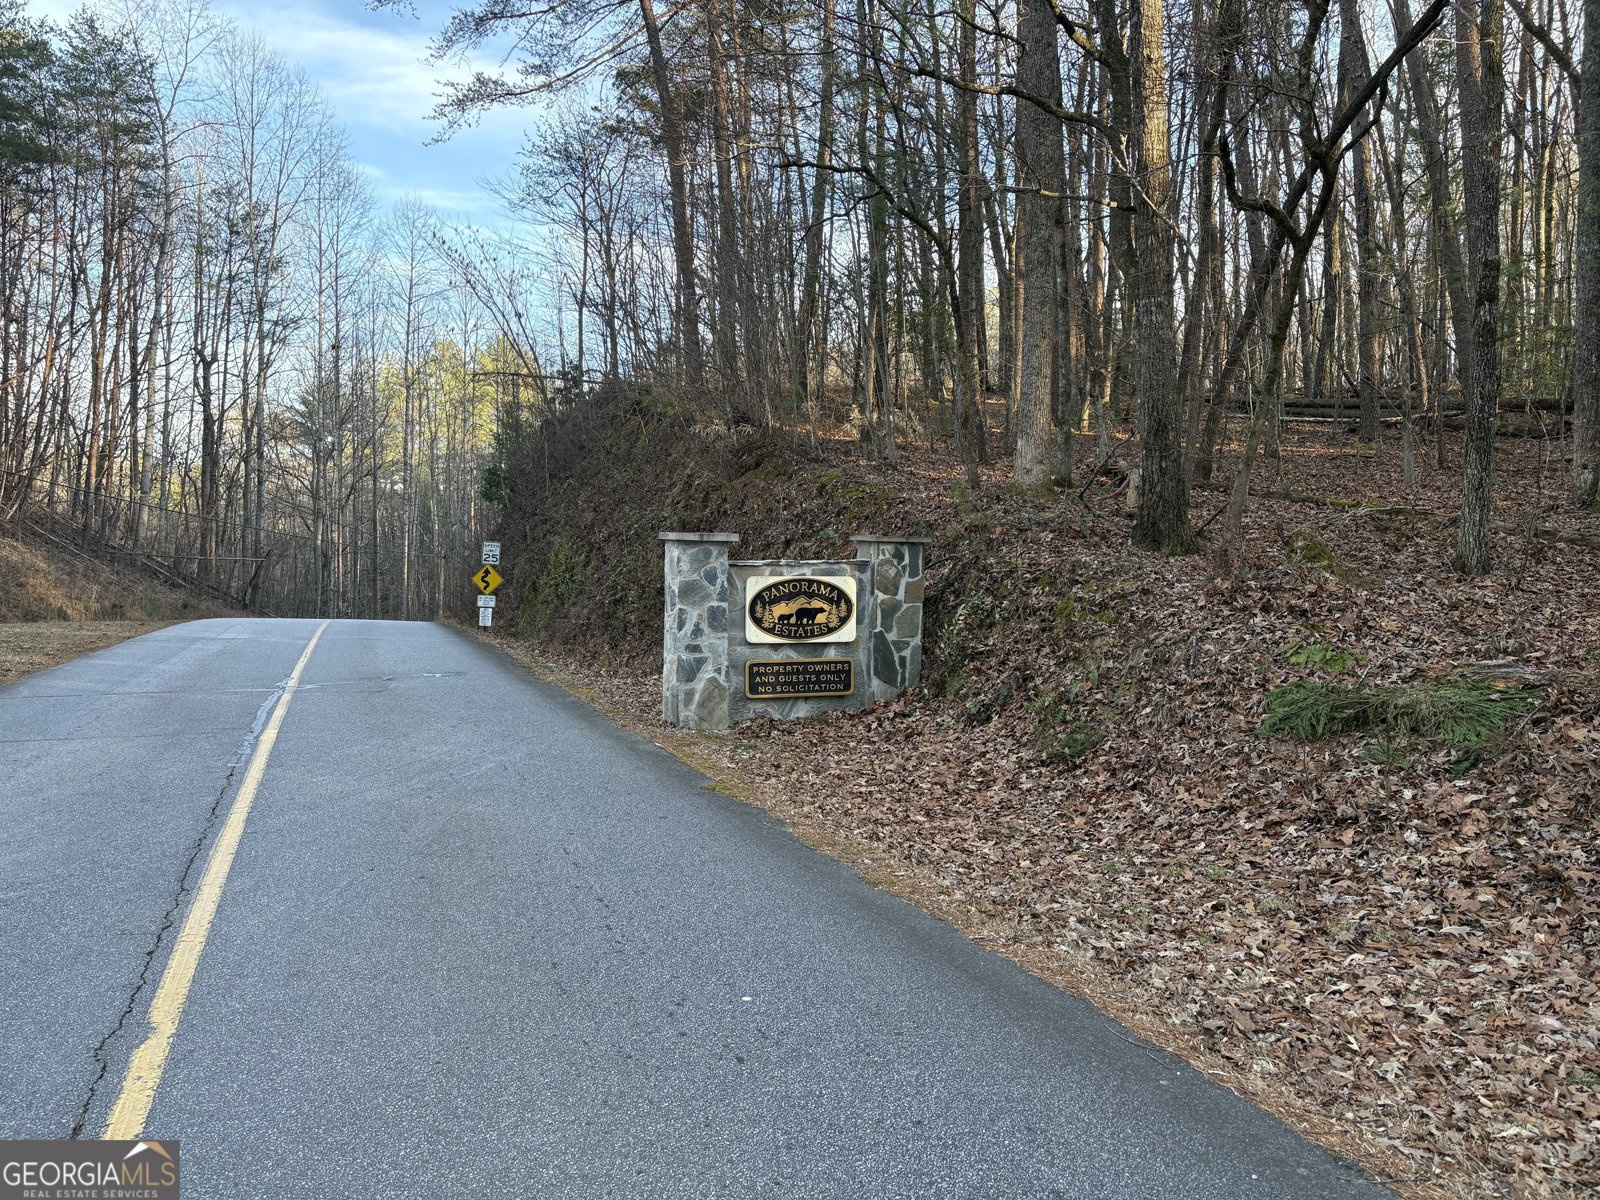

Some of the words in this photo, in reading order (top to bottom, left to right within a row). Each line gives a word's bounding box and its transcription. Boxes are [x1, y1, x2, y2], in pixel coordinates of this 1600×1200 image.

[484, 554, 498, 562] 25
[762, 581, 838, 601] PANORAMA
[774, 623, 828, 636] ESTATES
[753, 665, 804, 673] PROPERTY
[807, 663, 849, 672] OWNERS
[755, 675, 775, 683] AND
[779, 674, 816, 682] GUESTS
[820, 673, 846, 681] ONLY
[776, 683, 844, 692] SOLICITATION
